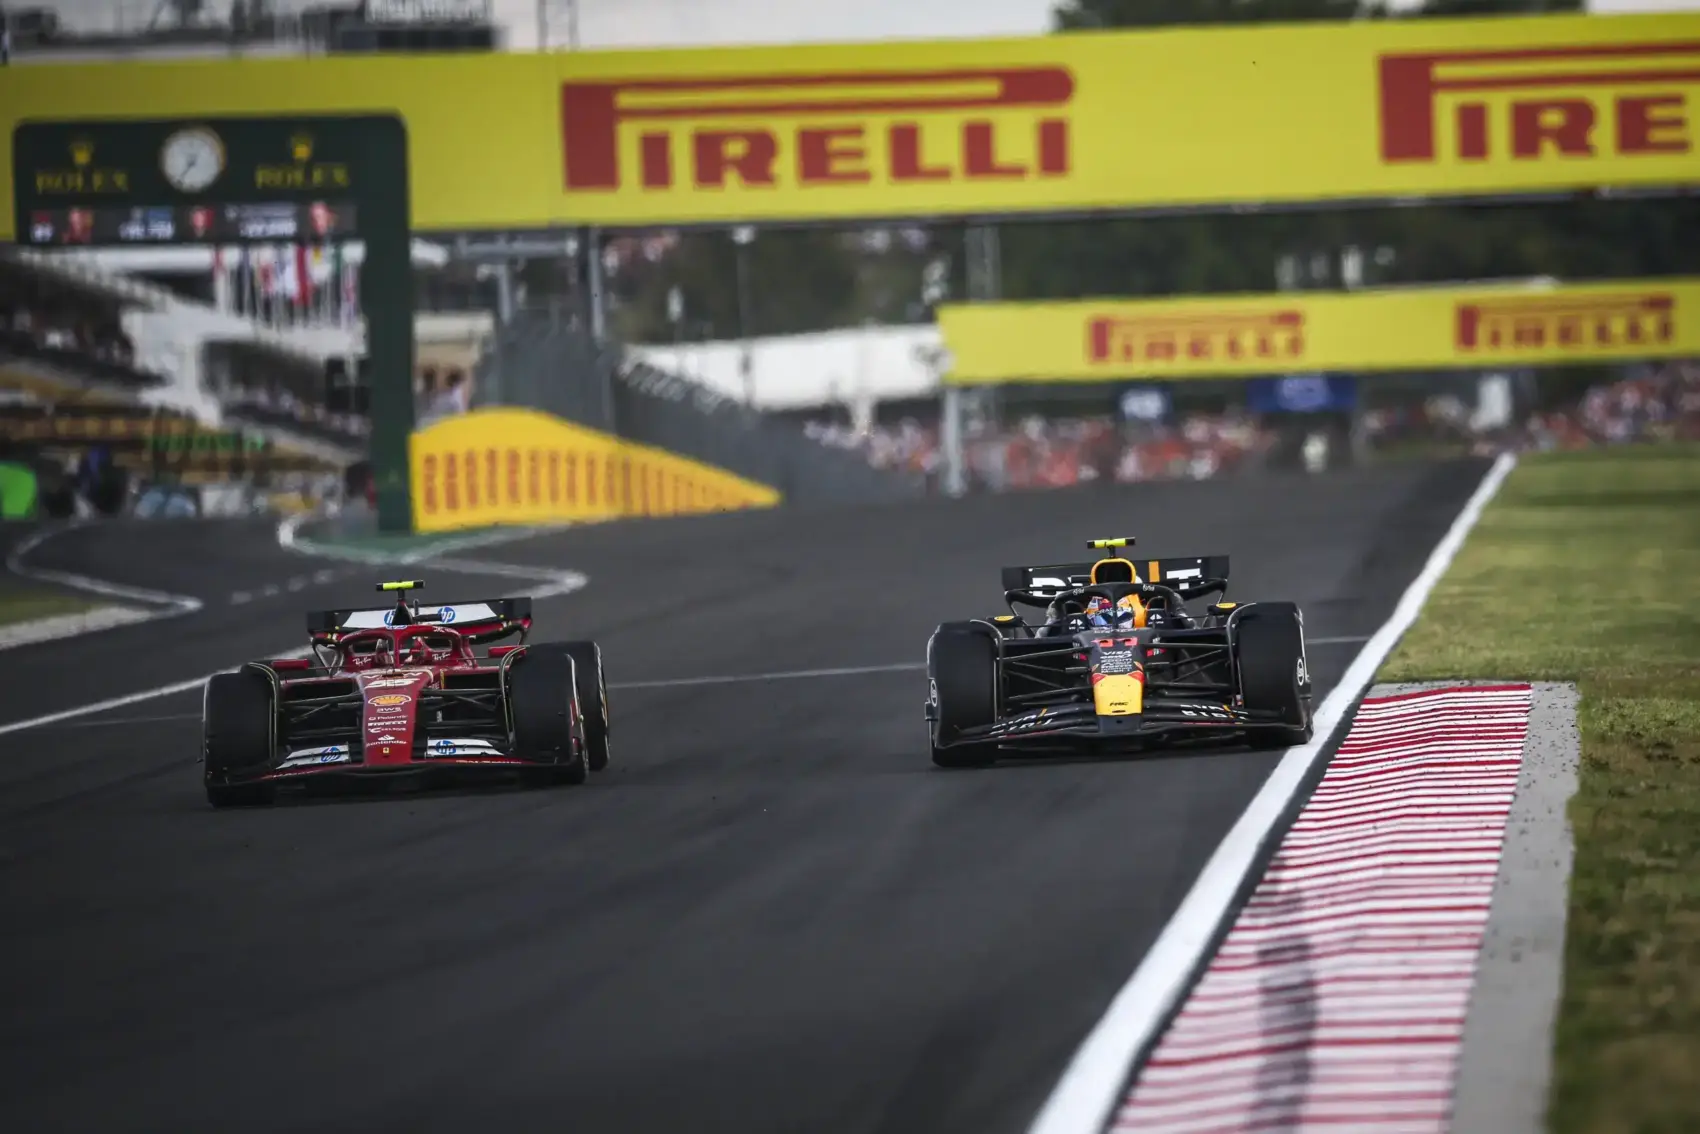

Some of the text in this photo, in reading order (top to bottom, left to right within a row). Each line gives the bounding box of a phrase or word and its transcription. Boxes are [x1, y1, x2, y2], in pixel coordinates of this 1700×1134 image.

[562, 66, 1073, 190] PIRELLI
[1090, 310, 1304, 362] PIRELLI
[1456, 294, 1675, 350] PIRELLI
[439, 606, 456, 624] hp
